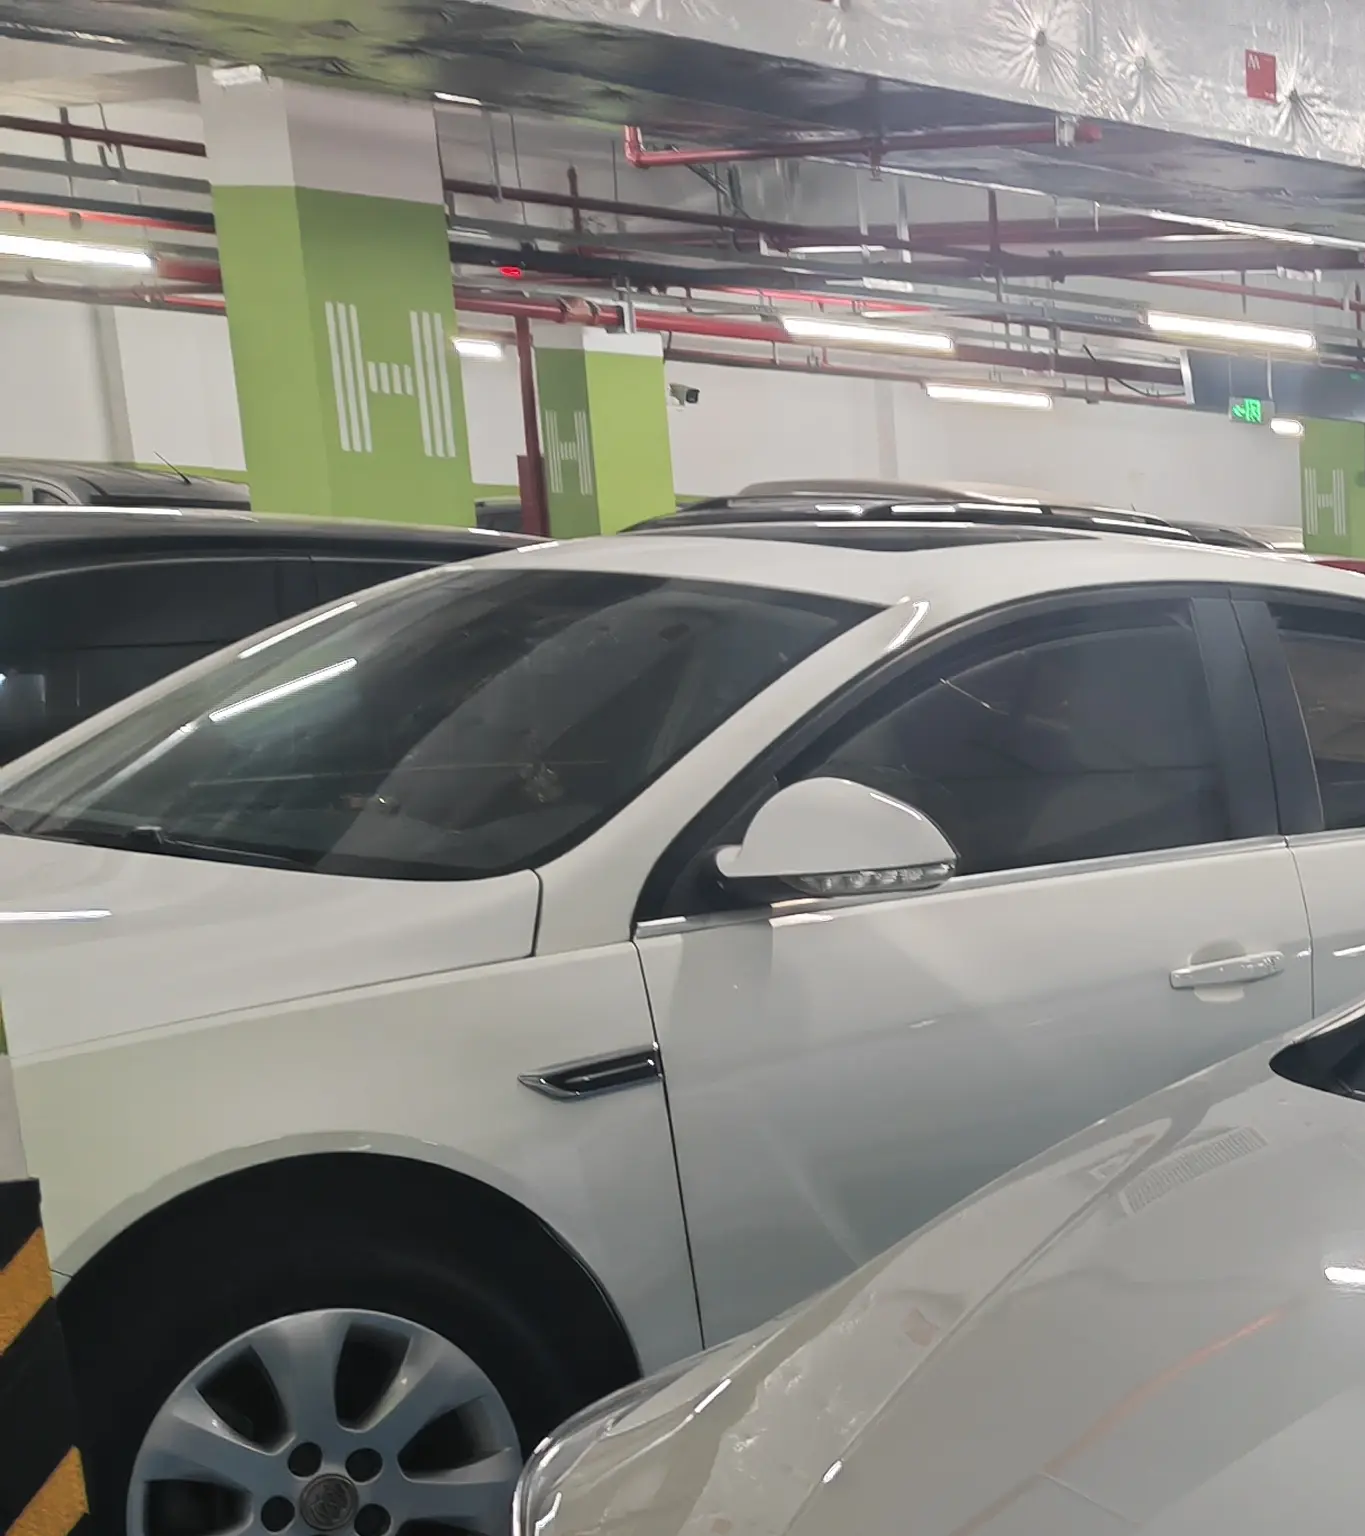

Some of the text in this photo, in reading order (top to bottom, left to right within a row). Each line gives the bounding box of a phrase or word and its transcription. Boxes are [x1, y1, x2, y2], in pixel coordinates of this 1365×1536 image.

[325, 301, 457, 458] H
[544, 410, 594, 496] H
[1304, 467, 1346, 536] H
